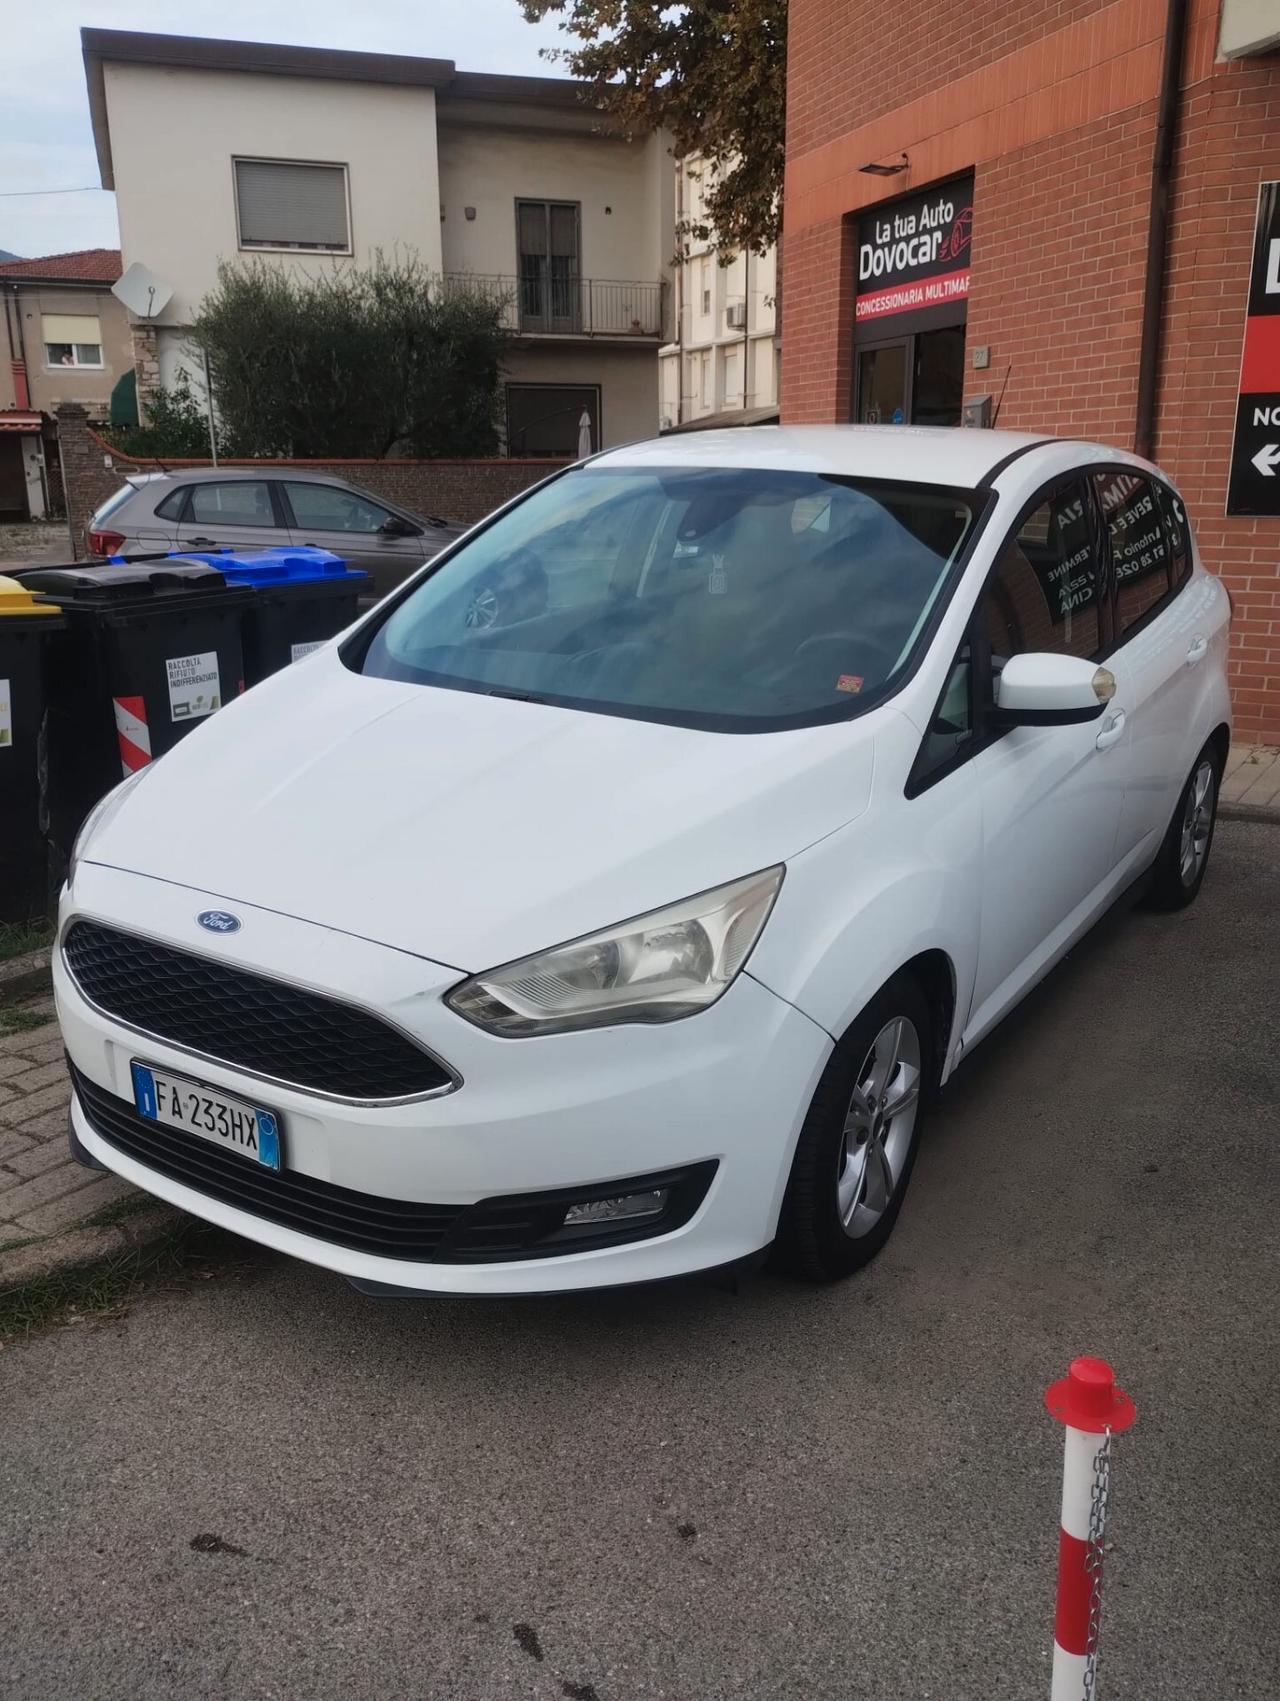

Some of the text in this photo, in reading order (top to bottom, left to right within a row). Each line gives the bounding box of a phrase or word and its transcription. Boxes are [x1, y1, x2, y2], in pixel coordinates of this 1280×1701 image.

[875, 199, 954, 244] La tua Auto
[859, 230, 943, 281] Dovocar
[855, 287, 923, 317] CONCESSIONARIA
[203, 912, 234, 930] Ford
